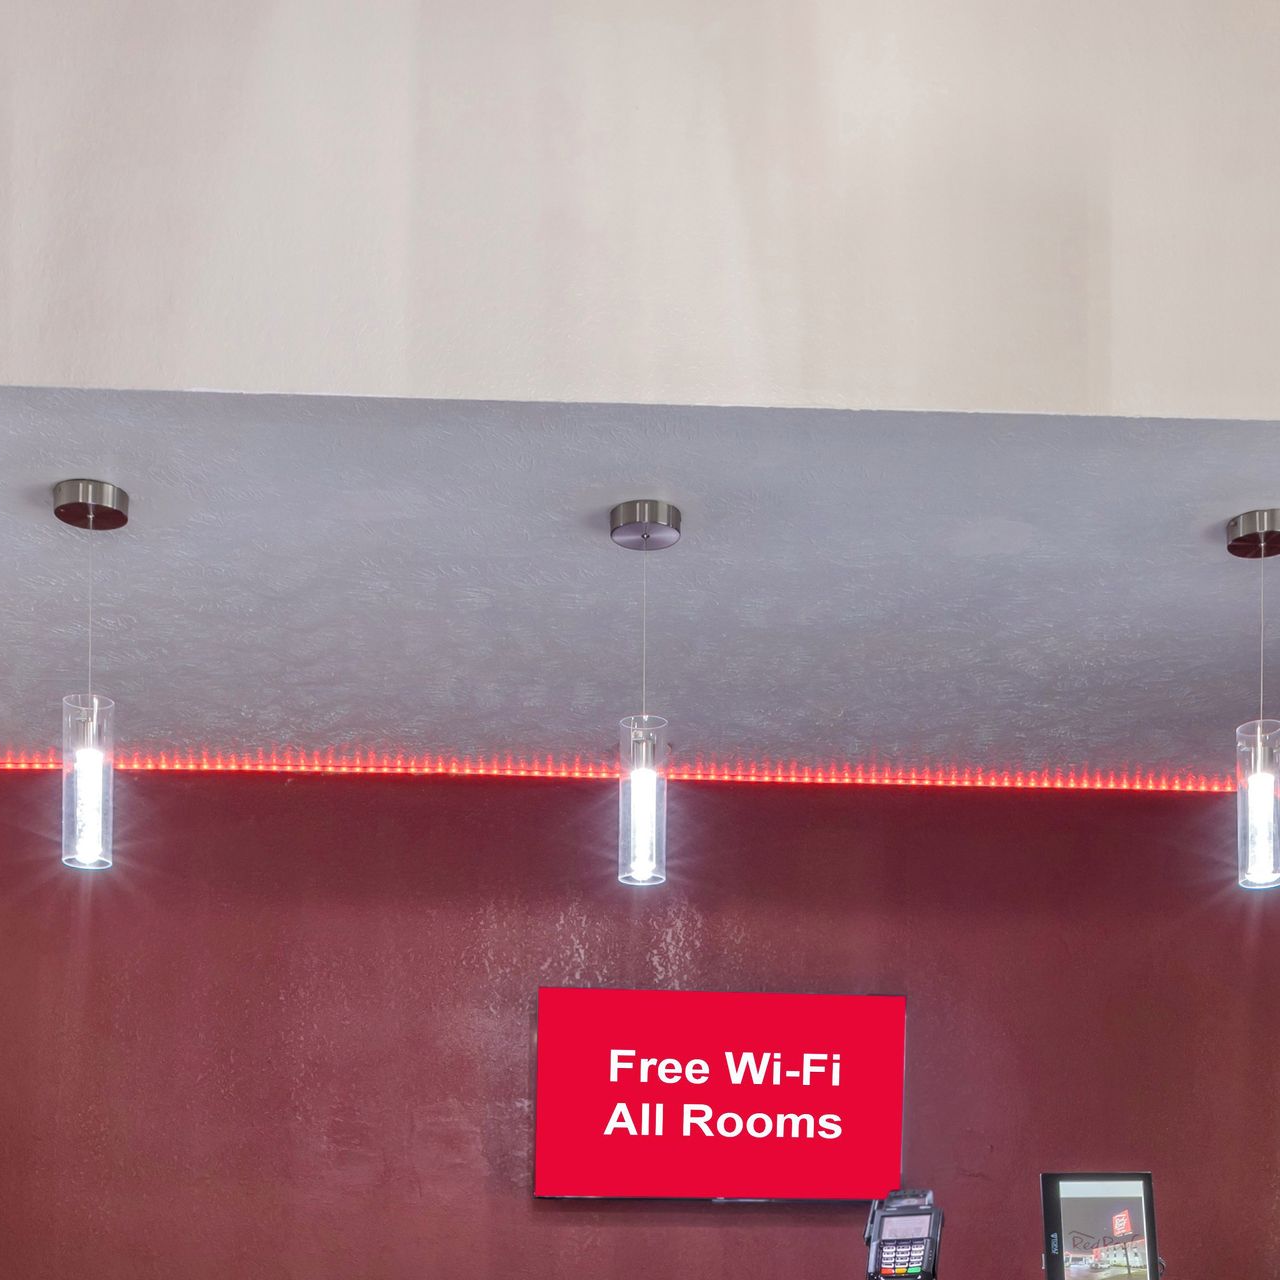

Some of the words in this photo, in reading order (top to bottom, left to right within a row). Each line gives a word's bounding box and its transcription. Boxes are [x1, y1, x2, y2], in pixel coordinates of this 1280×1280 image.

[610, 1049, 710, 1084] Free
[724, 1051, 841, 1086] Wi-Fi
[604, 1102, 664, 1136] All
[682, 1104, 842, 1139] Rooms
